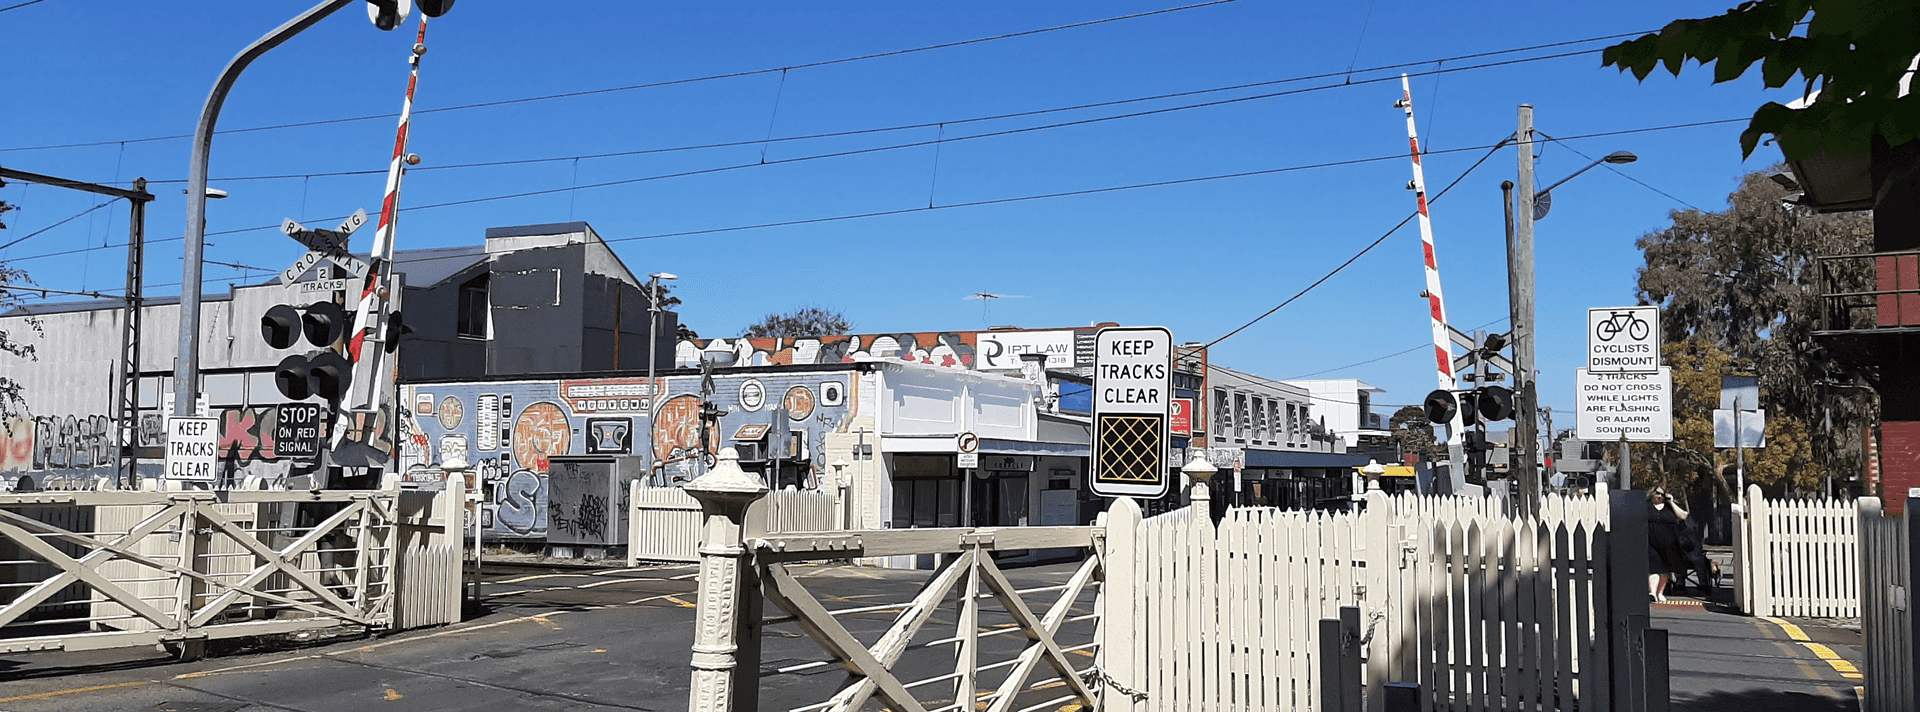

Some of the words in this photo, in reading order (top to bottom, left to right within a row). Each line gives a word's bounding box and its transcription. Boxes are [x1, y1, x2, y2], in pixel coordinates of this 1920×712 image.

[286, 214, 361, 281] CROSSING
[319, 268, 327, 279] 2
[304, 280, 343, 292] TRACKS
[1008, 345, 1031, 354] IPT
[1036, 343, 1068, 354] LAW
[1112, 339, 1154, 356] KEEP
[1593, 345, 1650, 353] CYCLISTS
[1592, 357, 1654, 366] DISMOUNT
[1100, 364, 1165, 380] TRACKS
[1597, 373, 1603, 381] 2
[1607, 373, 1648, 381] TRACKS
[1625, 383, 1662, 391] CROSS
[1104, 387, 1159, 404] CLEAR
[1586, 394, 1619, 402] WHILE
[1621, 394, 1659, 402] LIGHTS
[279, 407, 317, 423] STOP
[178, 421, 208, 436] KEEP
[278, 427, 292, 438] ON
[297, 427, 316, 438] RED
[170, 441, 214, 457] TRACKS
[278, 441, 313, 453] SIGNAL
[171, 461, 210, 477] CLEAR
